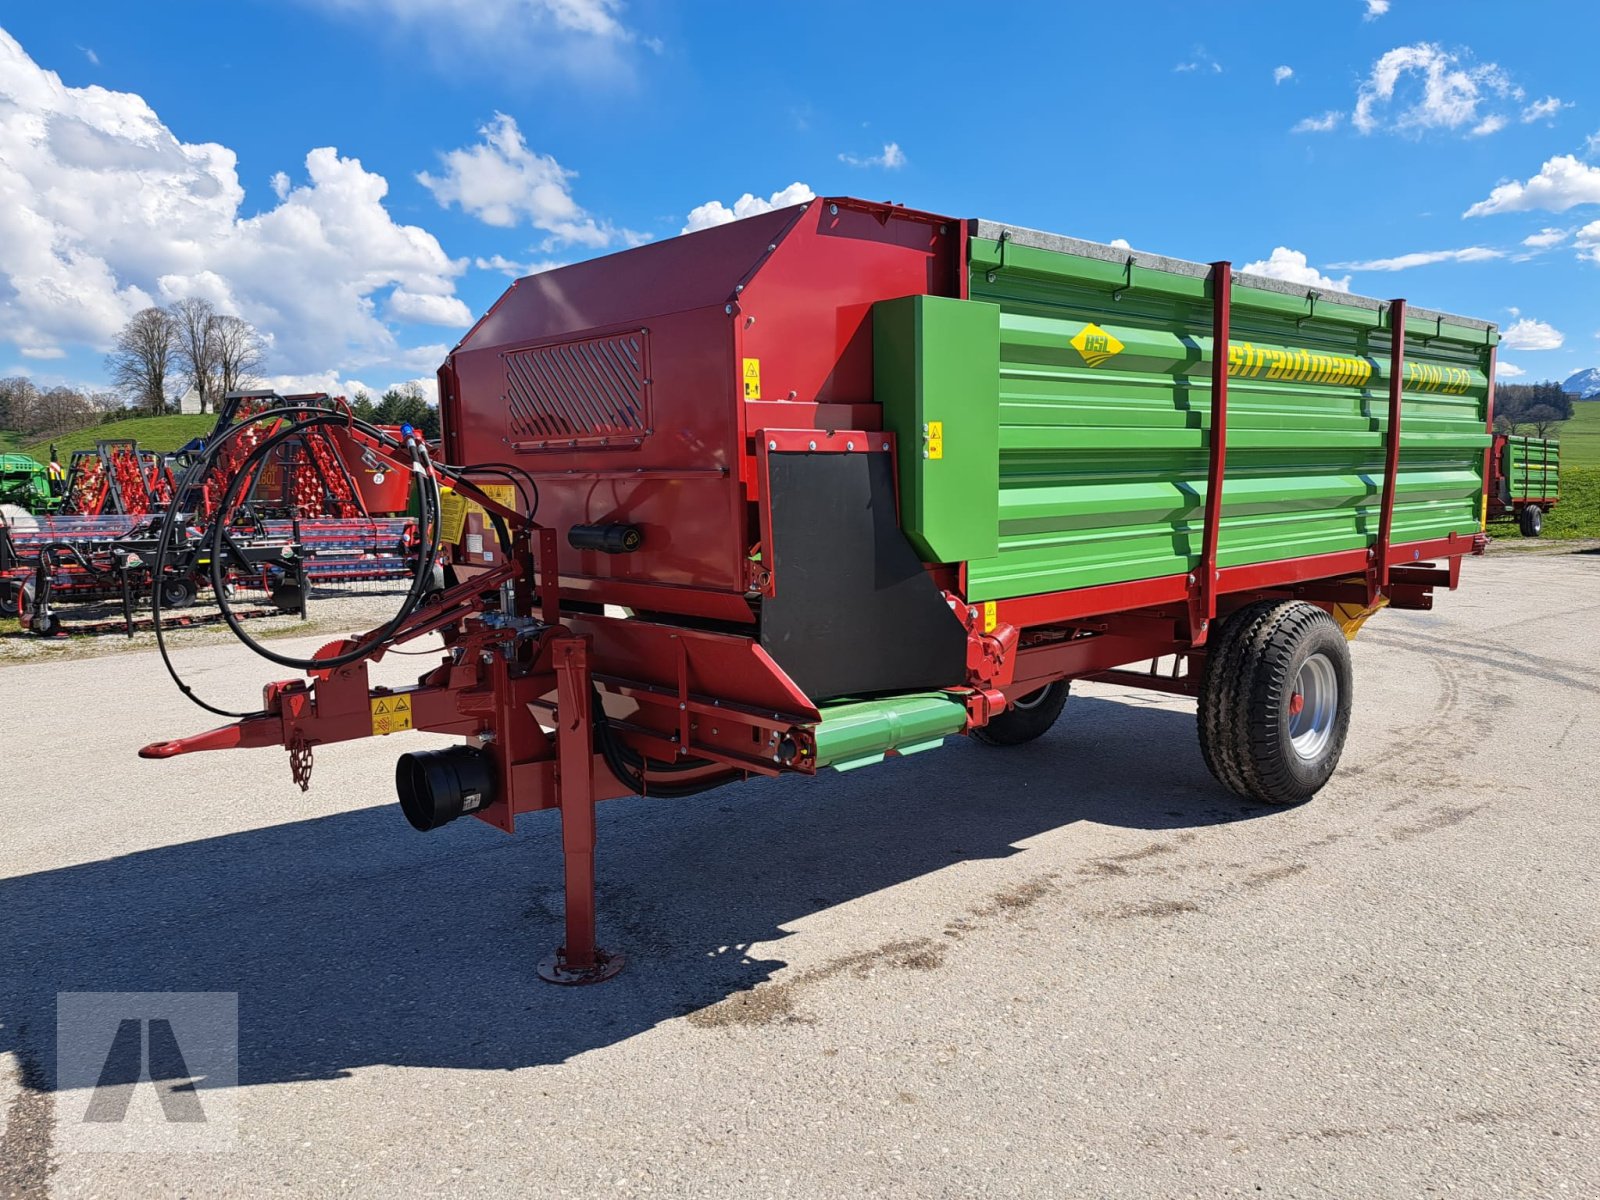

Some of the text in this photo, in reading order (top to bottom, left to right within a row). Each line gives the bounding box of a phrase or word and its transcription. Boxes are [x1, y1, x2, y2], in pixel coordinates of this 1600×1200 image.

[1227, 343, 1372, 386] strautmann
[1405, 362, 1472, 395] FVW 120
